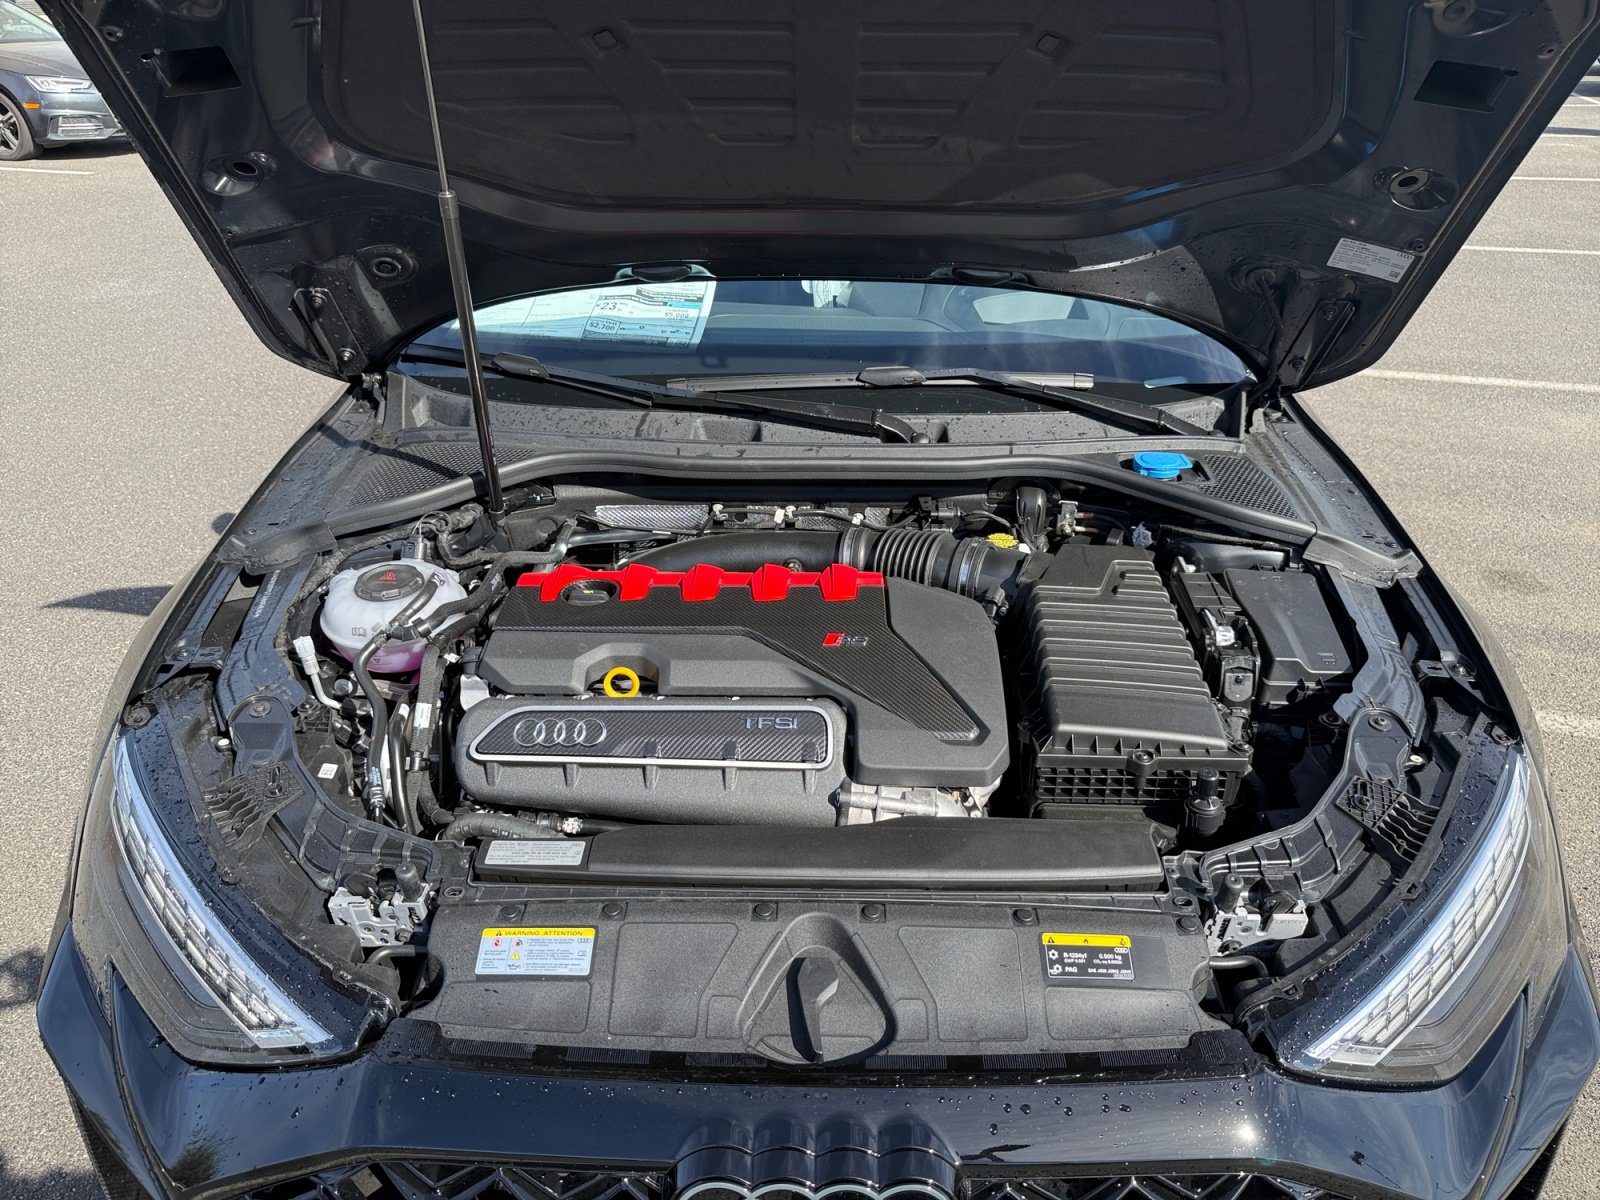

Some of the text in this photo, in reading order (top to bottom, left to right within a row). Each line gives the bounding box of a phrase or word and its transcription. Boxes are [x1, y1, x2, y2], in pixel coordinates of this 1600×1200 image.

[600, 302, 617, 310] 23
[589, 322, 615, 331] $2,700
[739, 717, 798, 729] TFSI
